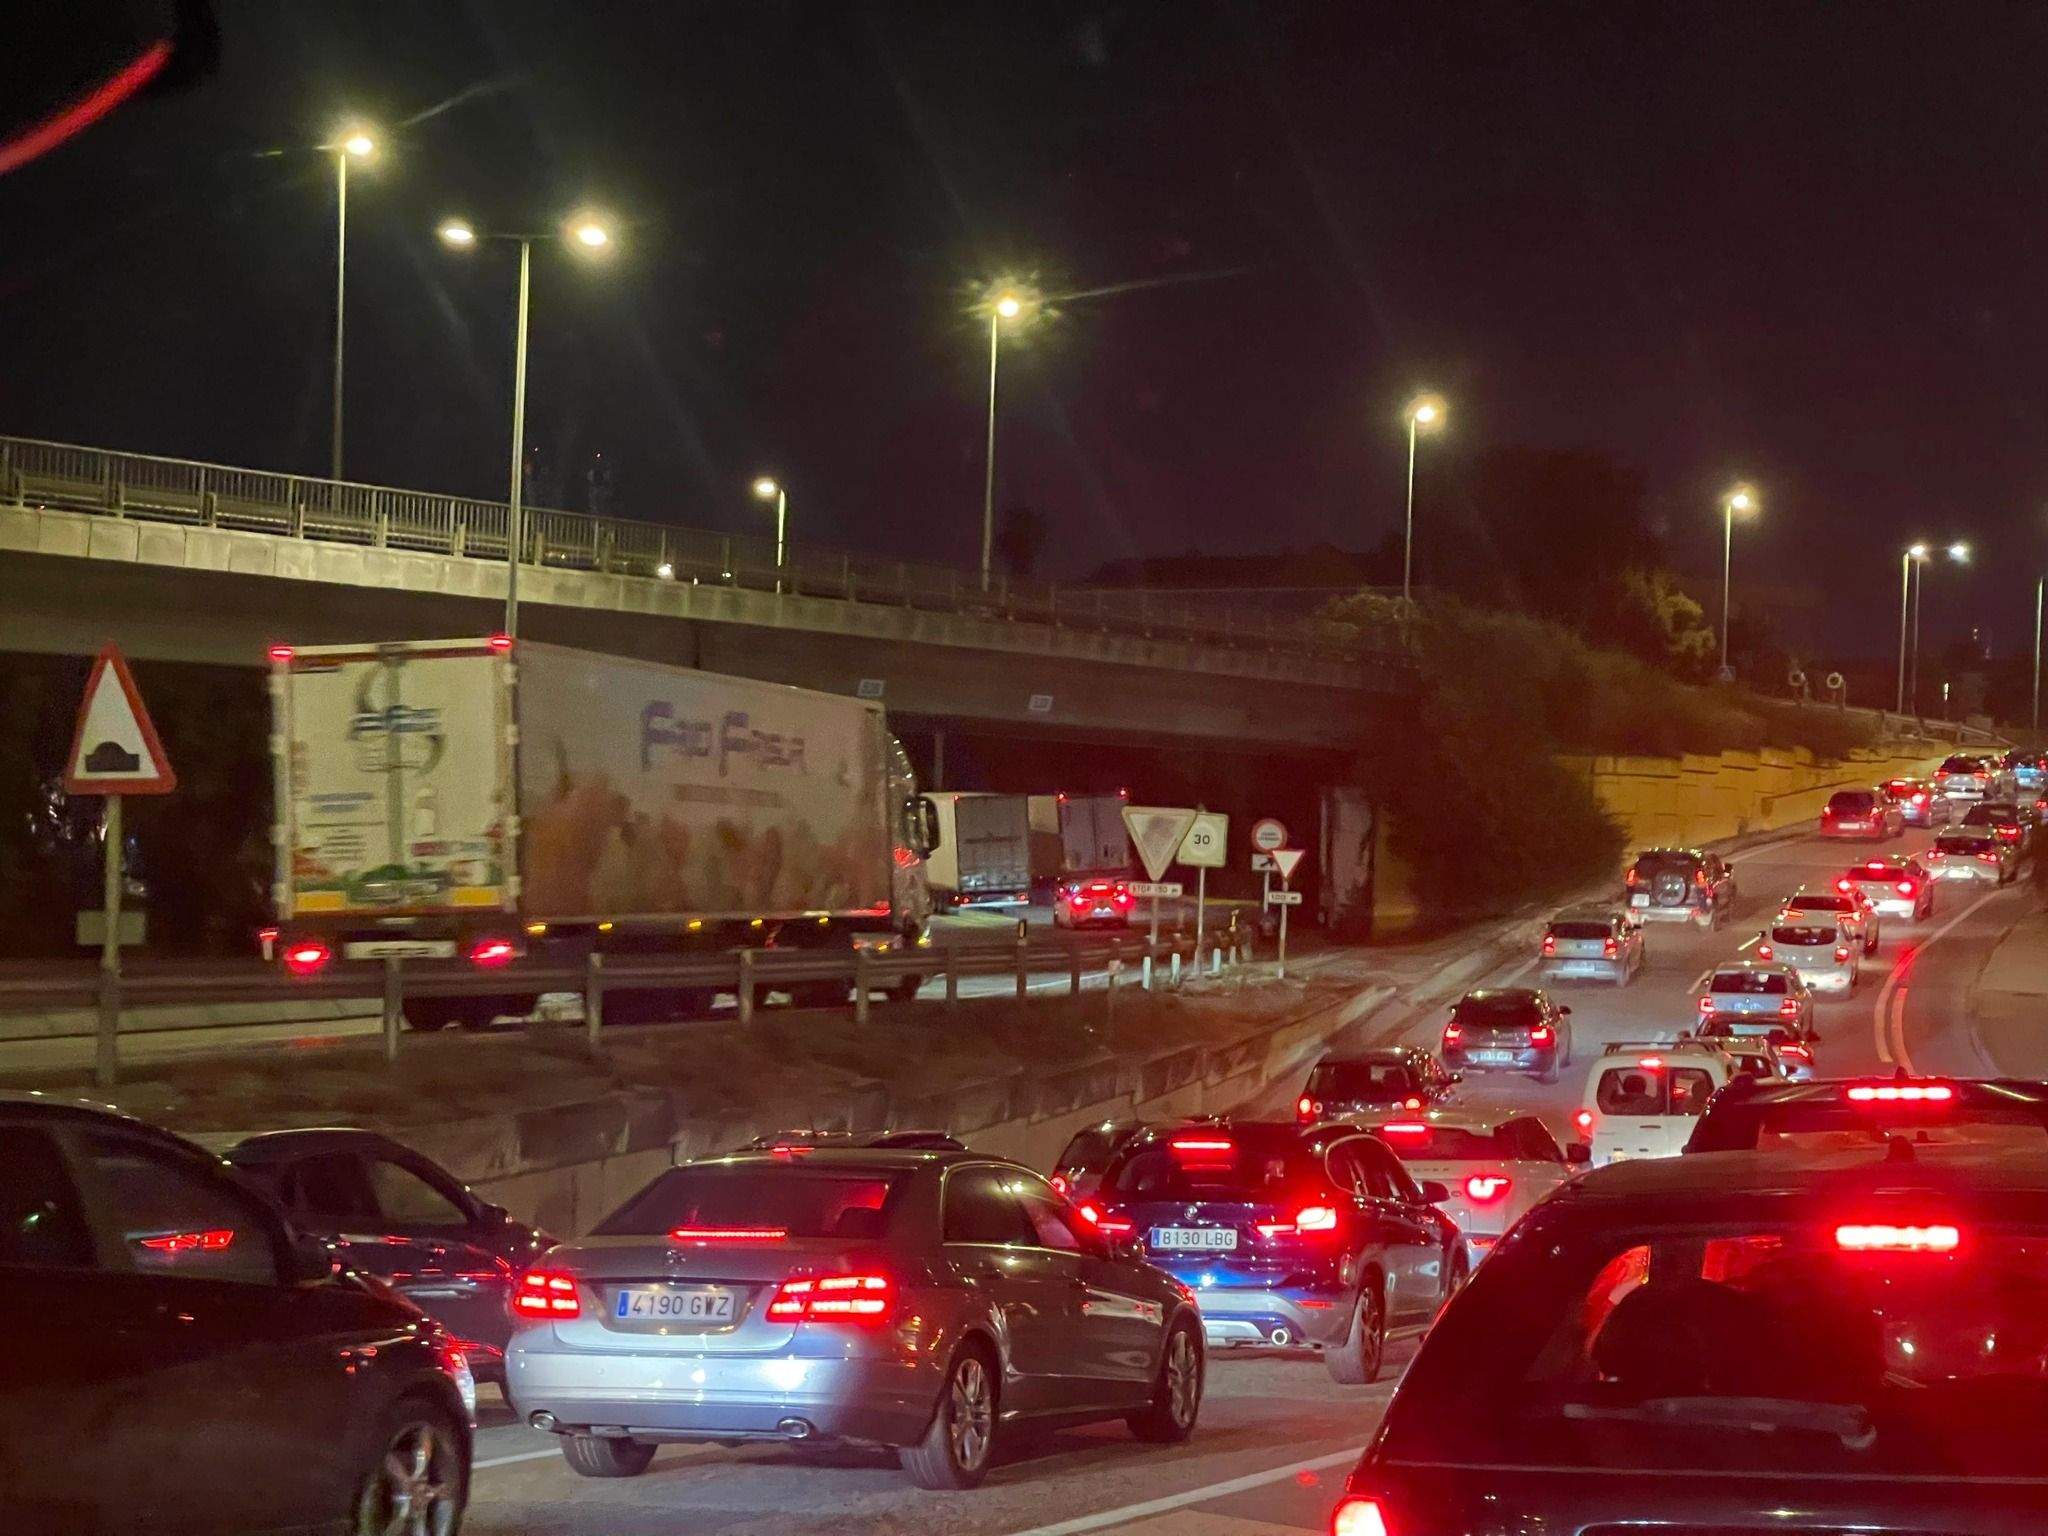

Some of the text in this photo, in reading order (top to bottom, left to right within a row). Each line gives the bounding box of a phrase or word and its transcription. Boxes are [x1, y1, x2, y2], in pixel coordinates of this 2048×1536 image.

[1194, 834, 1210, 845] 30
[1162, 1231, 1233, 1246] 8130 LBG
[632, 1295, 729, 1316] 4190 GWZ
